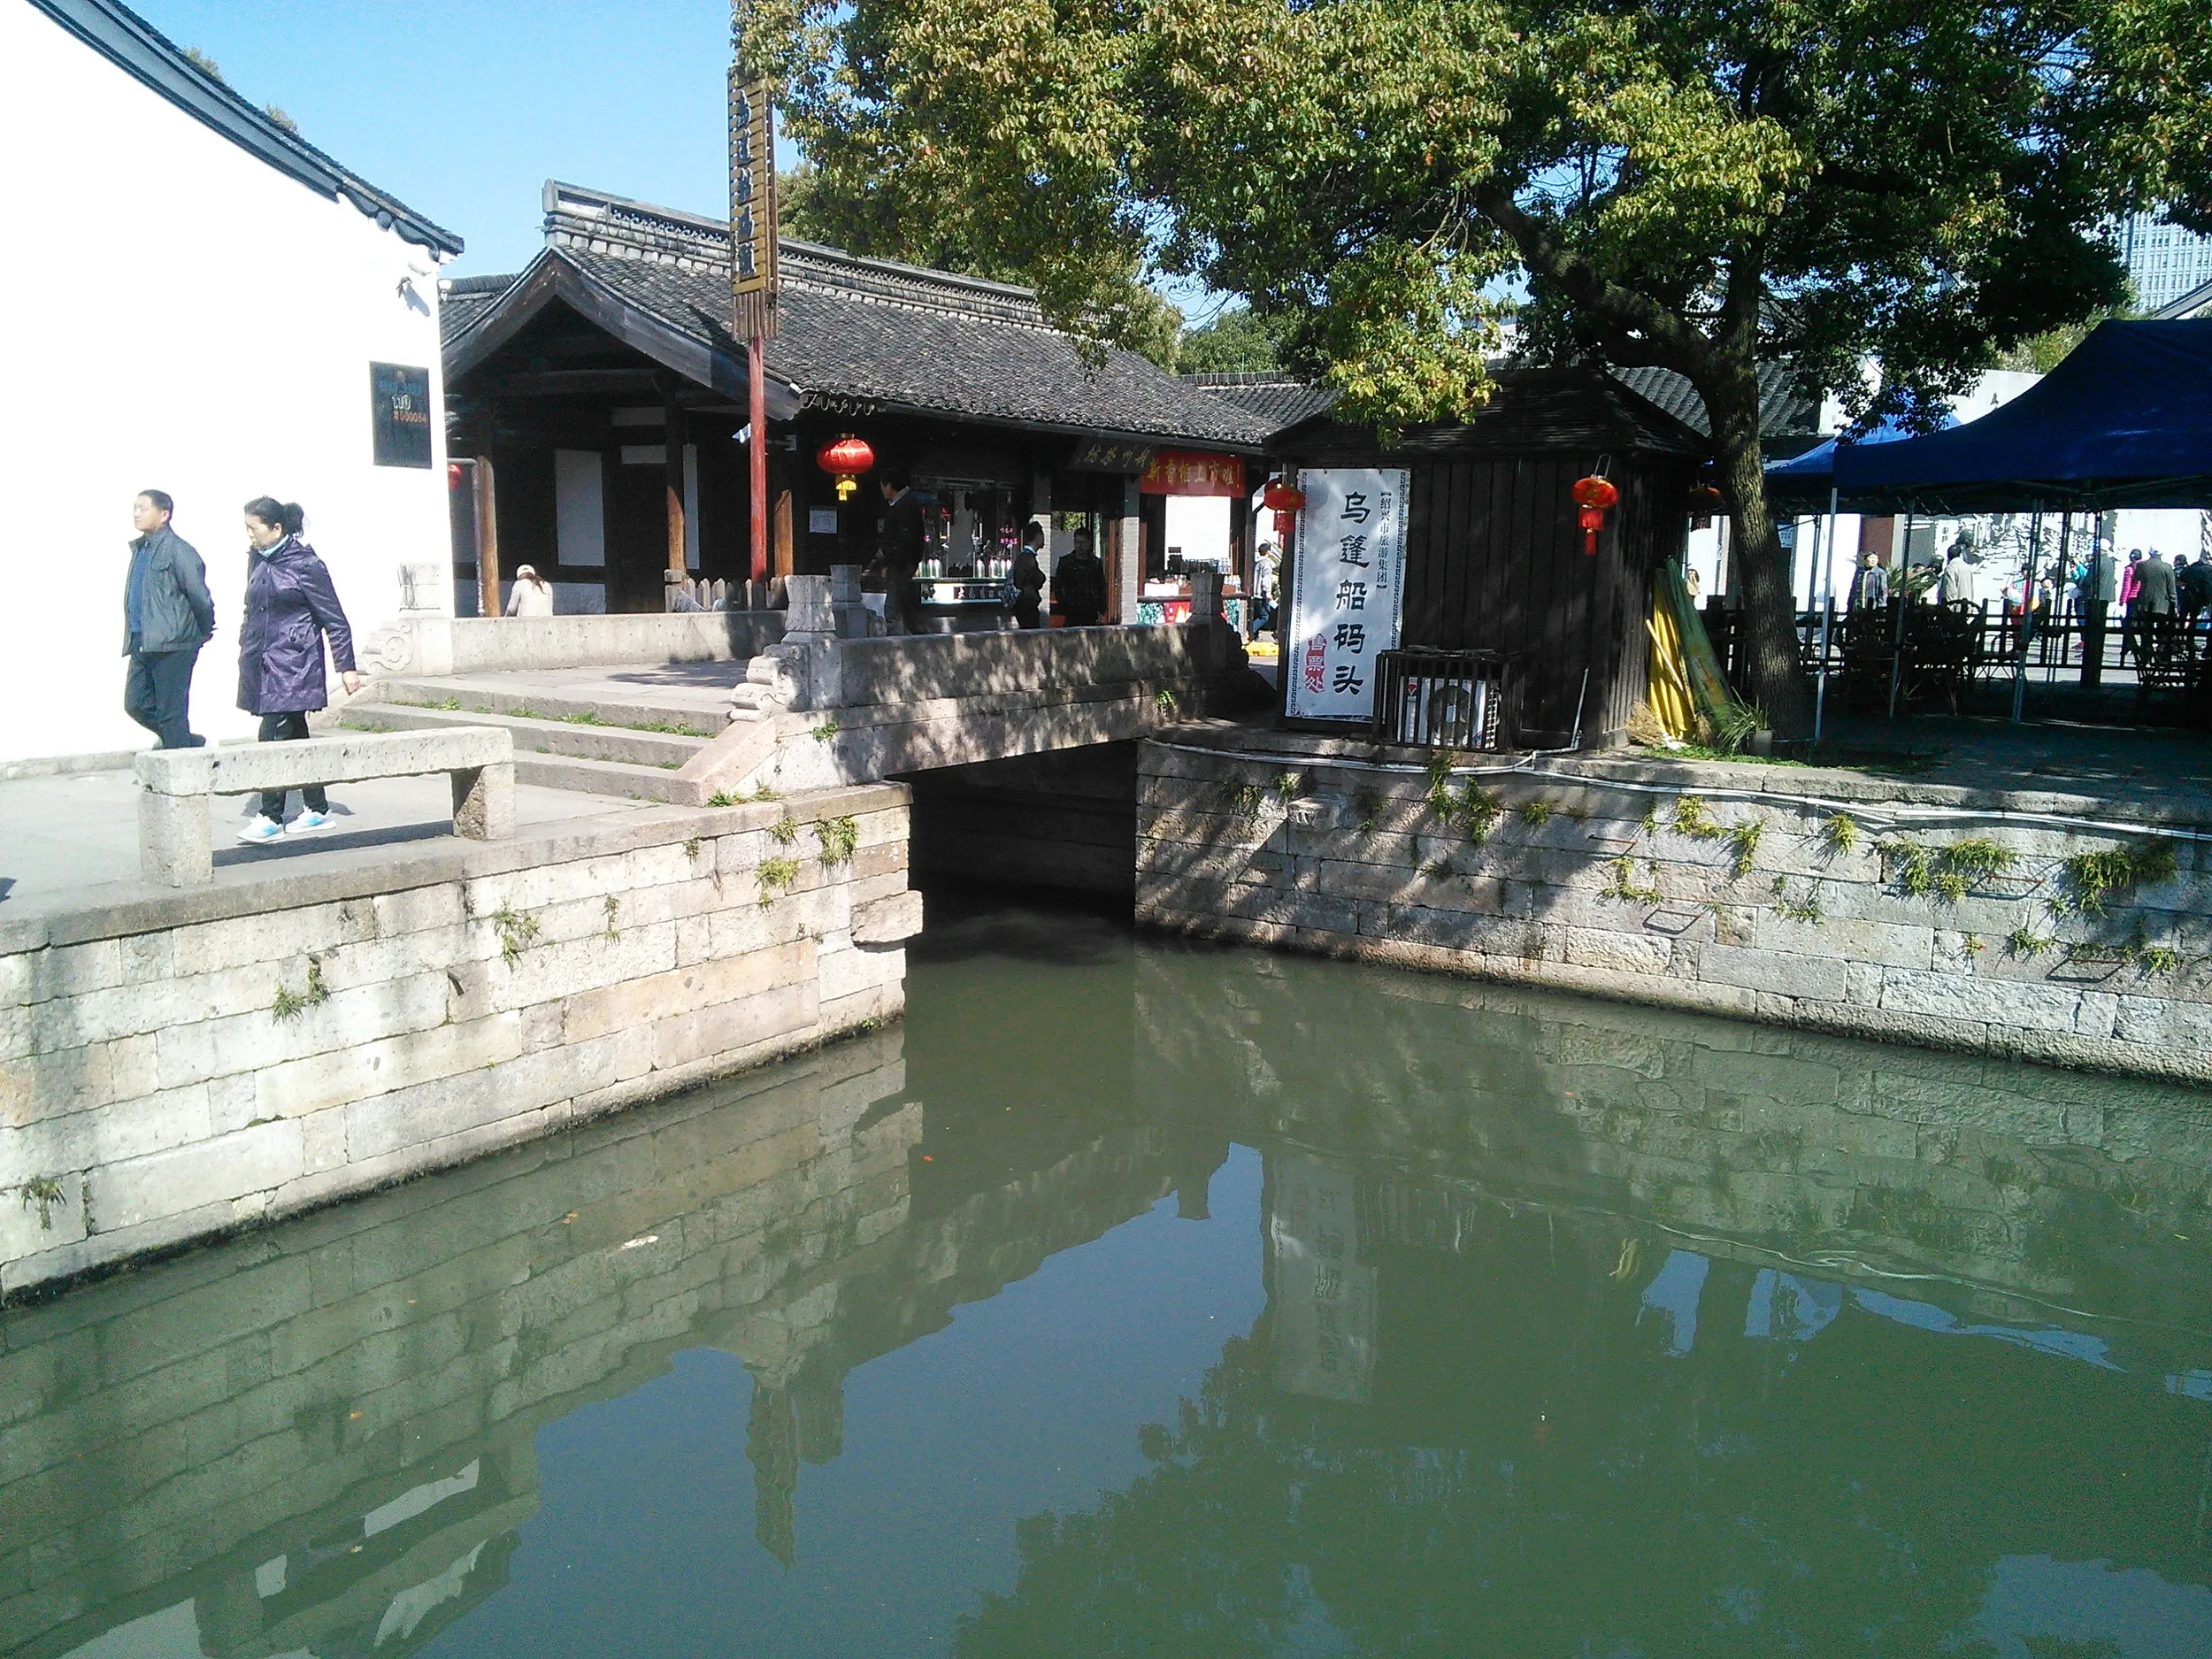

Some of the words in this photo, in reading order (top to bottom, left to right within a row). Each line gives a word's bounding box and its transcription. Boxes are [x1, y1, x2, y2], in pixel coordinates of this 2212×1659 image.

[1333, 491, 1371, 695] 乌篷船码头
[1305, 633, 1326, 693] 售票处
